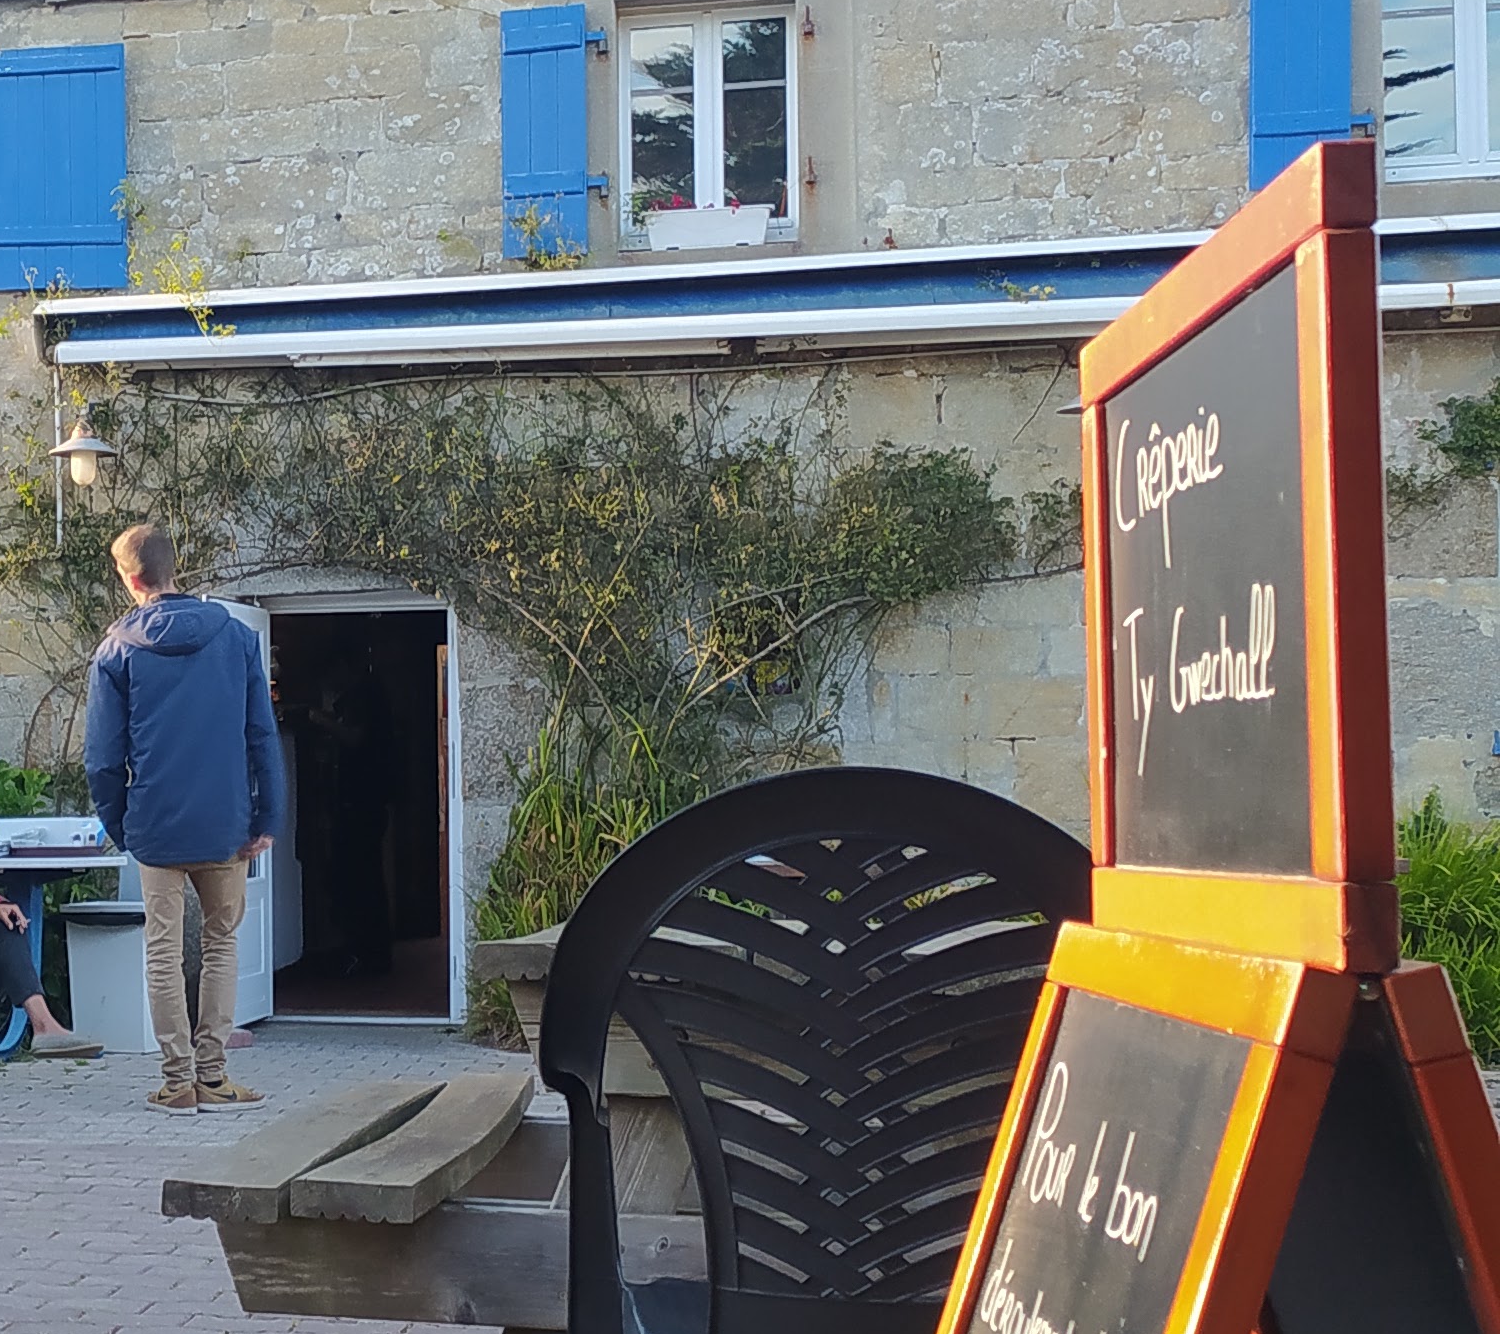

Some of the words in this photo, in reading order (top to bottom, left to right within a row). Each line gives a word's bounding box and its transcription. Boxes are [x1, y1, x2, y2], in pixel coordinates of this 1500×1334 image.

[1122, 608, 1155, 776] Ty
[1169, 583, 1275, 713] Gwechall
[1077, 1121, 1107, 1223] le
[1104, 1131, 1158, 1262] bon
